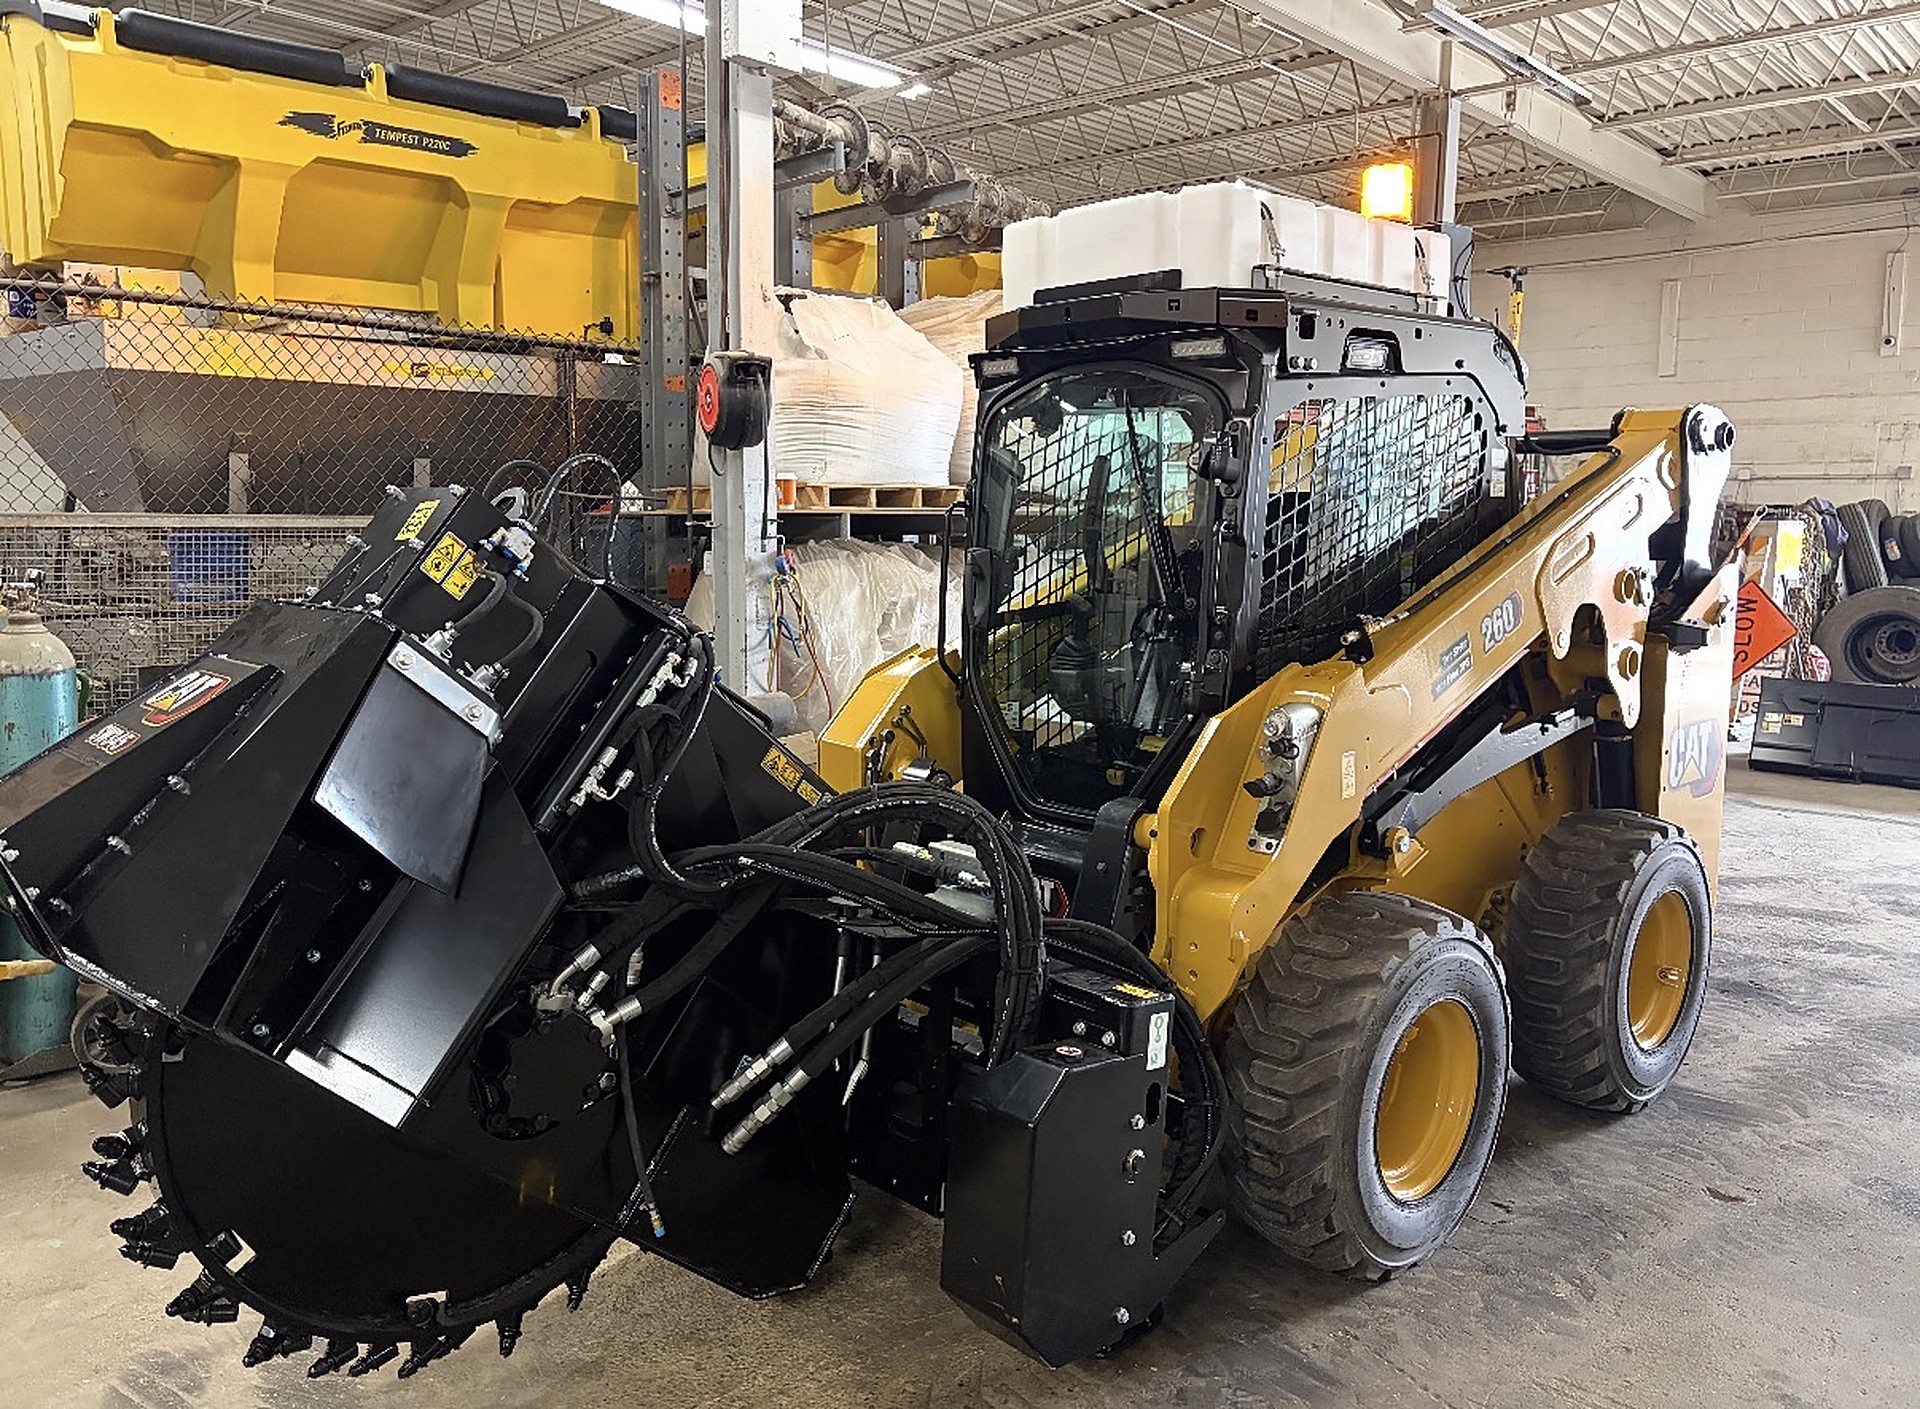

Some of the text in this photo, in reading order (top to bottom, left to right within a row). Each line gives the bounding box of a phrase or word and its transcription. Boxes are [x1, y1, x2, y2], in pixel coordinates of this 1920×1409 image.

[374, 128, 418, 145] TEMPEST
[1481, 599, 1514, 653] 260
[1734, 598, 1759, 663] SLOW
[1669, 720, 1714, 788] CAT
